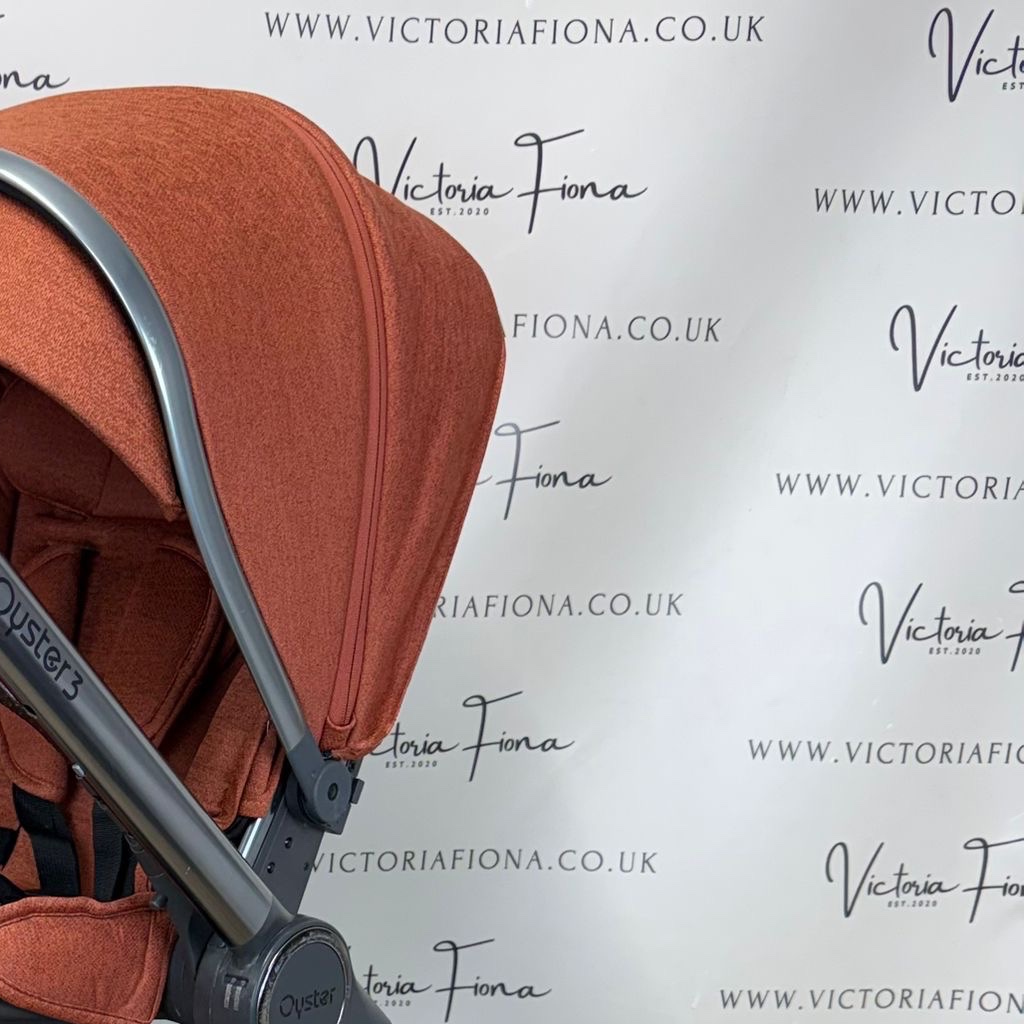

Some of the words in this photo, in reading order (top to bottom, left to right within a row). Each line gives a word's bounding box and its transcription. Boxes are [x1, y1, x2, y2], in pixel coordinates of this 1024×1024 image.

[264, 11, 765, 45] WWW.VICTORIAFIONA.CO.UK
[353, 136, 514, 205] Victoria
[514, 129, 648, 234] Fiona
[430, 207, 490, 216] EST.2020
[814, 188, 1024, 216] WWW.VICTO
[494, 420, 613, 521] Fiona
[859, 581, 1003, 664] Victoria
[929, 647, 981, 655] EST.2020
[462, 691, 575, 782] Fiona
[385, 761, 438, 769] EST.2020
[826, 842, 960, 918] Victoria
[962, 837, 1024, 923] Fio
[887, 900, 938, 908] EST.2020
[433, 938, 552, 1023] Fiona
[279, 987, 337, 1020] Oyster
